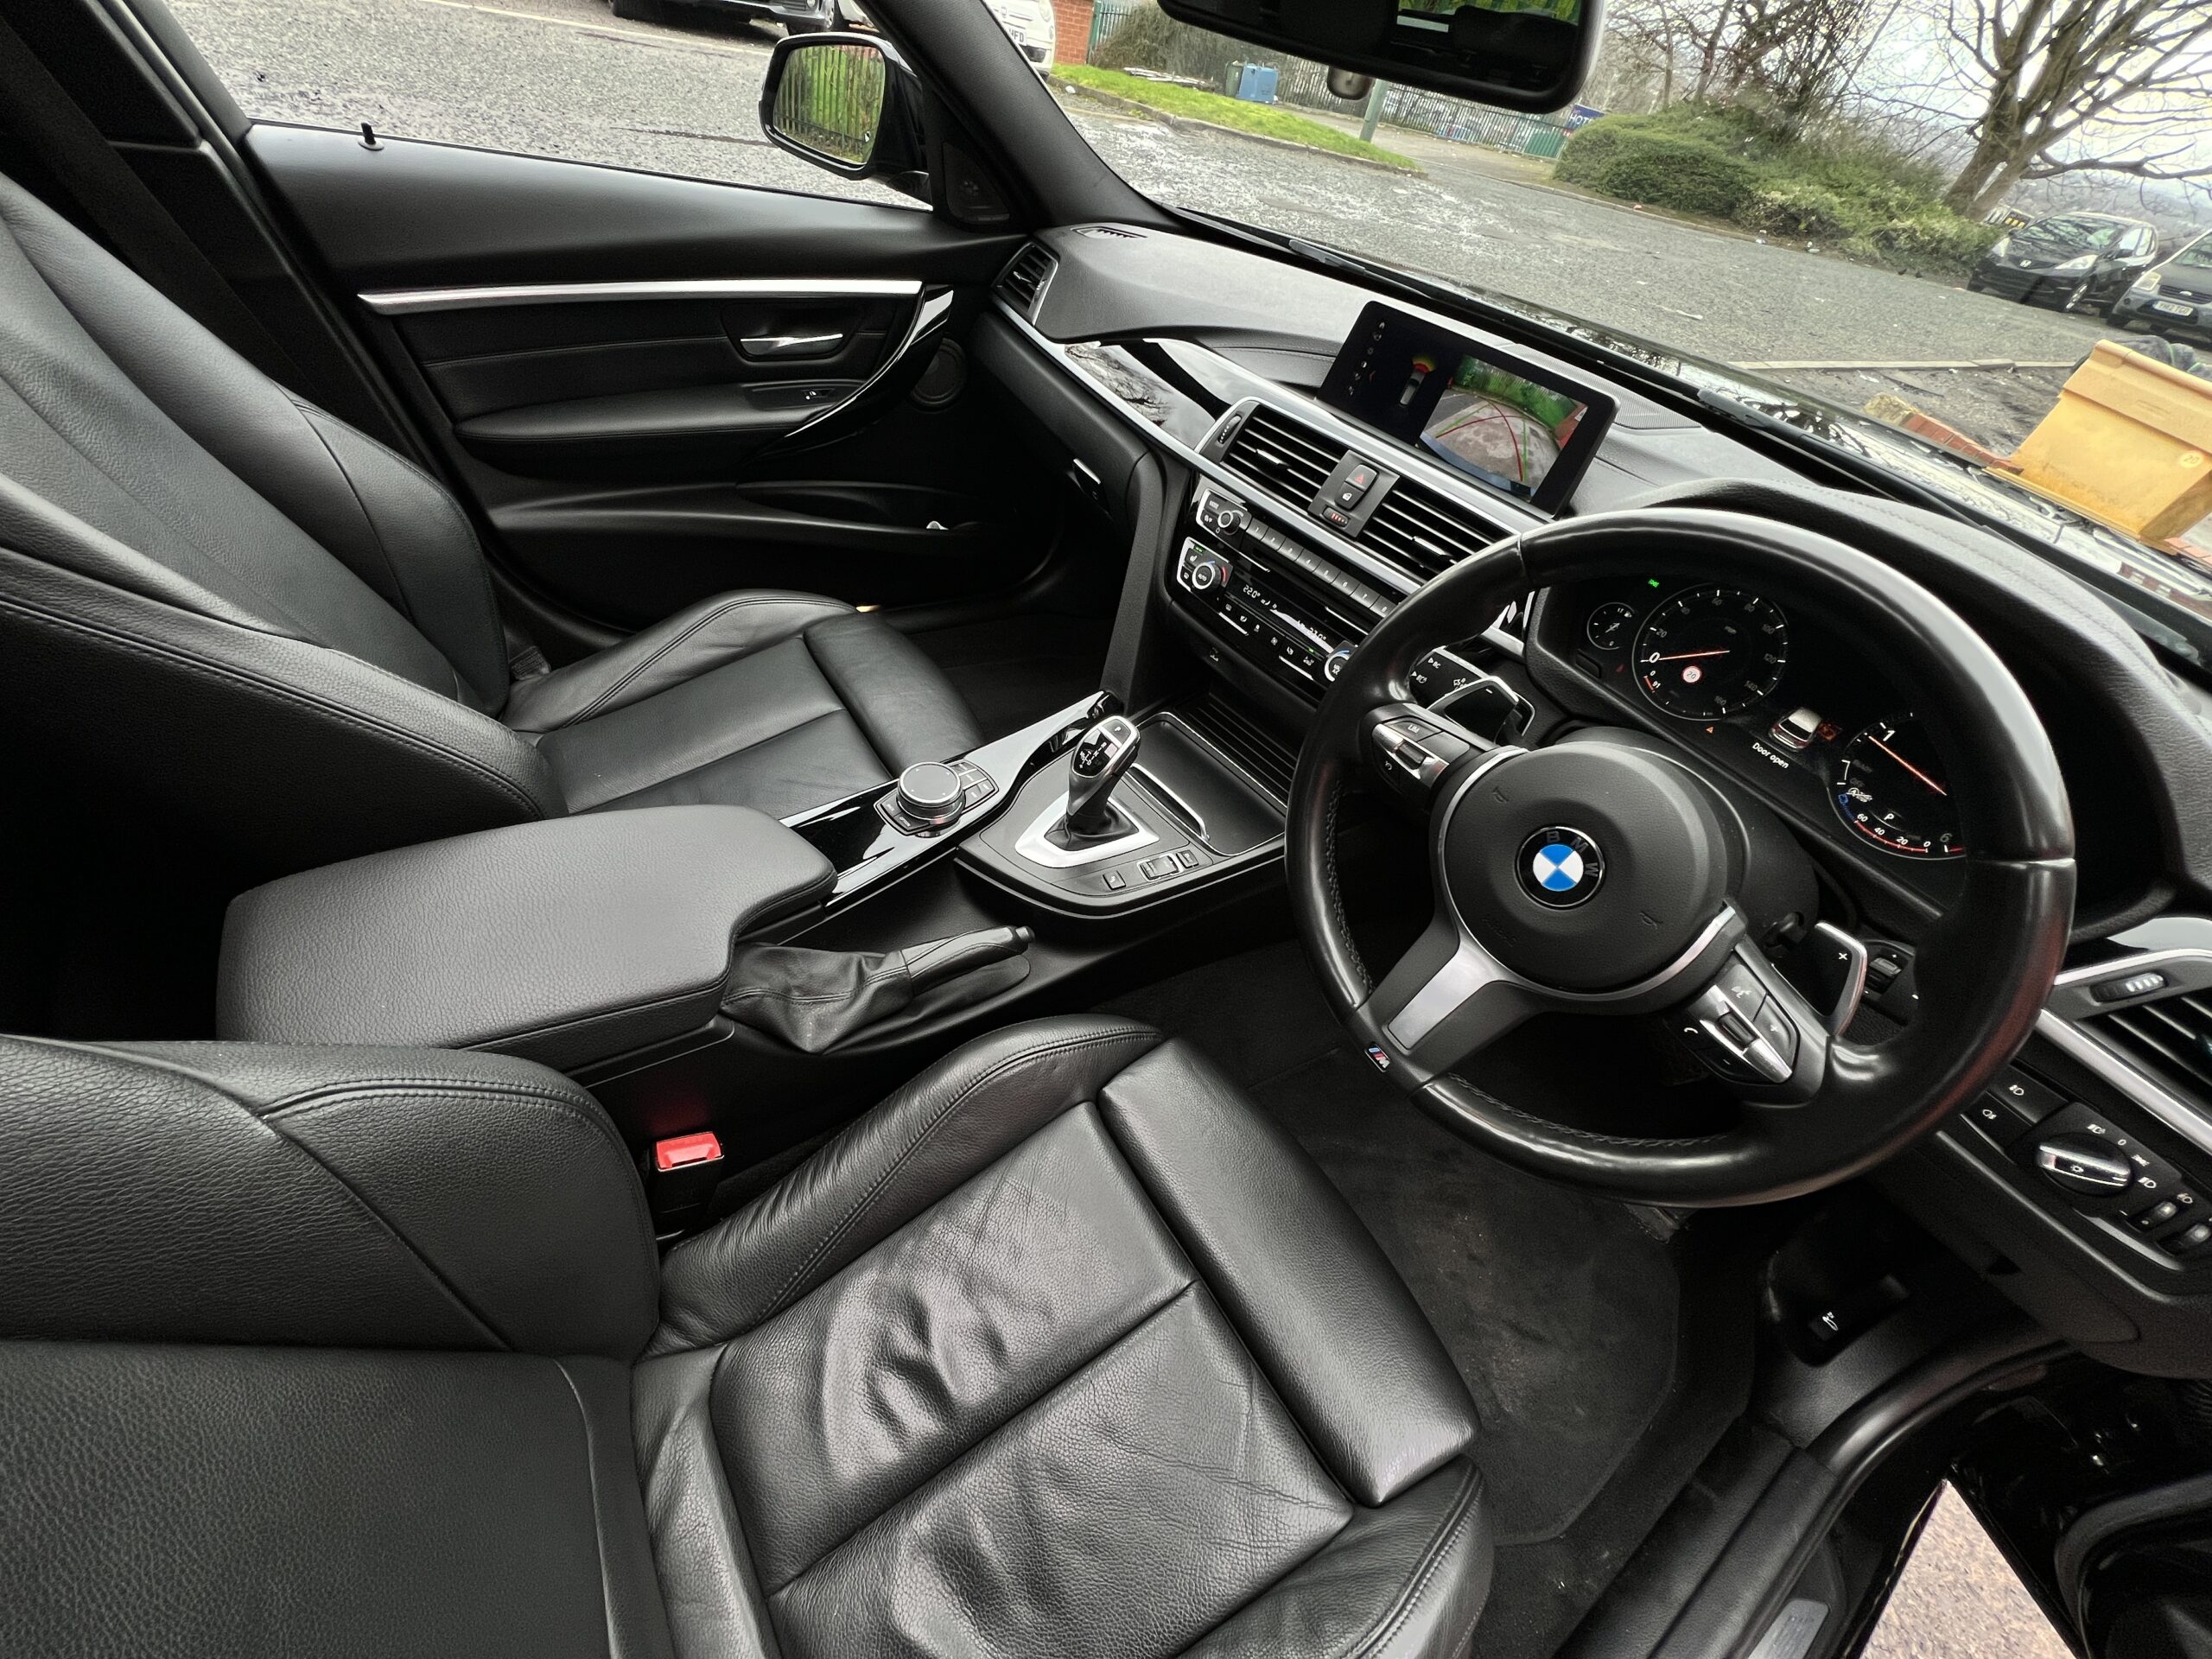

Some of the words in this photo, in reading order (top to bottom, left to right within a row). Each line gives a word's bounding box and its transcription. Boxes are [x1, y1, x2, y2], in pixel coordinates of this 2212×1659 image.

[1656, 628, 1668, 639] 20
[1649, 652, 1661, 664] 0
[1751, 742, 1771, 758] Door
[1769, 753, 1789, 769] open
[1857, 813, 1868, 823] 60
[1874, 827, 1885, 836] 40
[1897, 836, 1908, 845] 20
[1545, 830, 1599, 878] BMW
